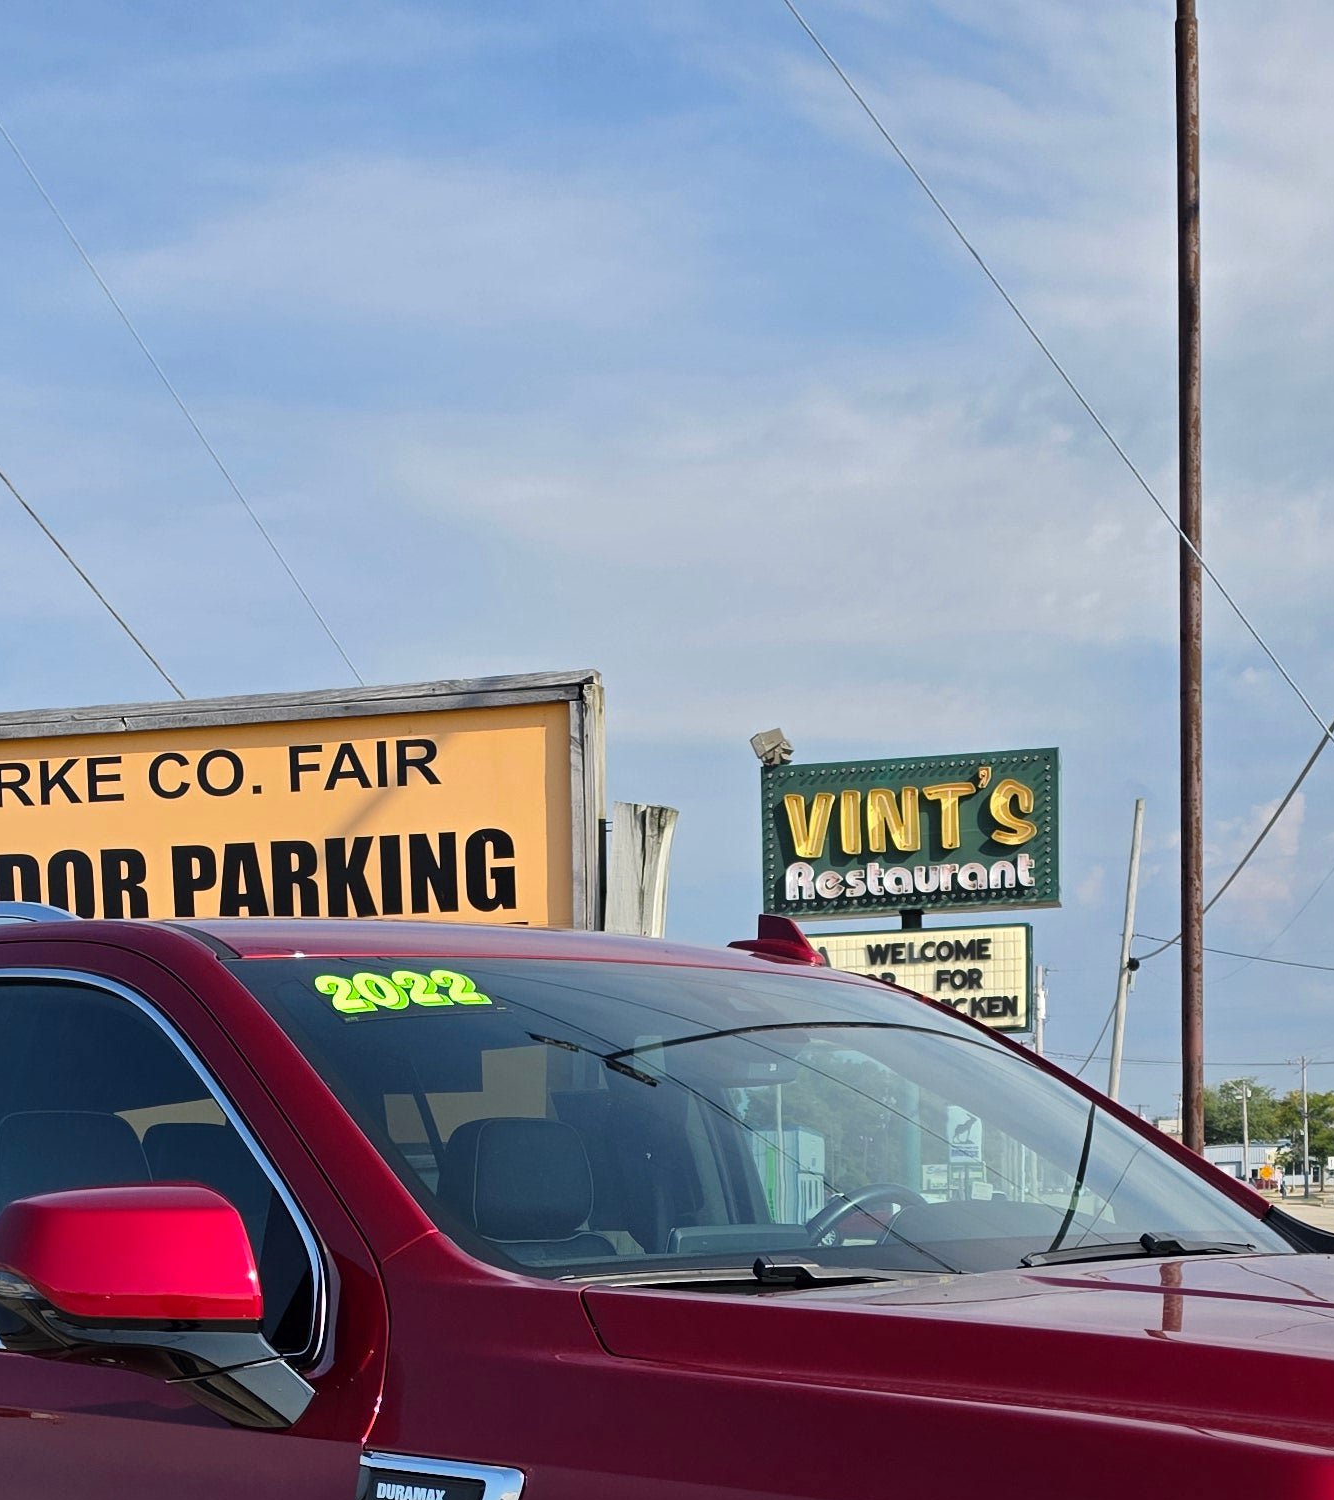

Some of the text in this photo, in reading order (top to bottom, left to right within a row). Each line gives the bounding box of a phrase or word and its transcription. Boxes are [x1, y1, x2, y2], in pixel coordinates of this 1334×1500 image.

[148, 749, 263, 799] CO.
[288, 738, 442, 792] FAIR
[784, 766, 1038, 859] VINT'S
[171, 827, 516, 919] PARKING
[785, 853, 1036, 901] Restaurant
[867, 938, 993, 966] WELCOME
[314, 969, 493, 1014] 2022
[936, 968, 984, 992] FOR
